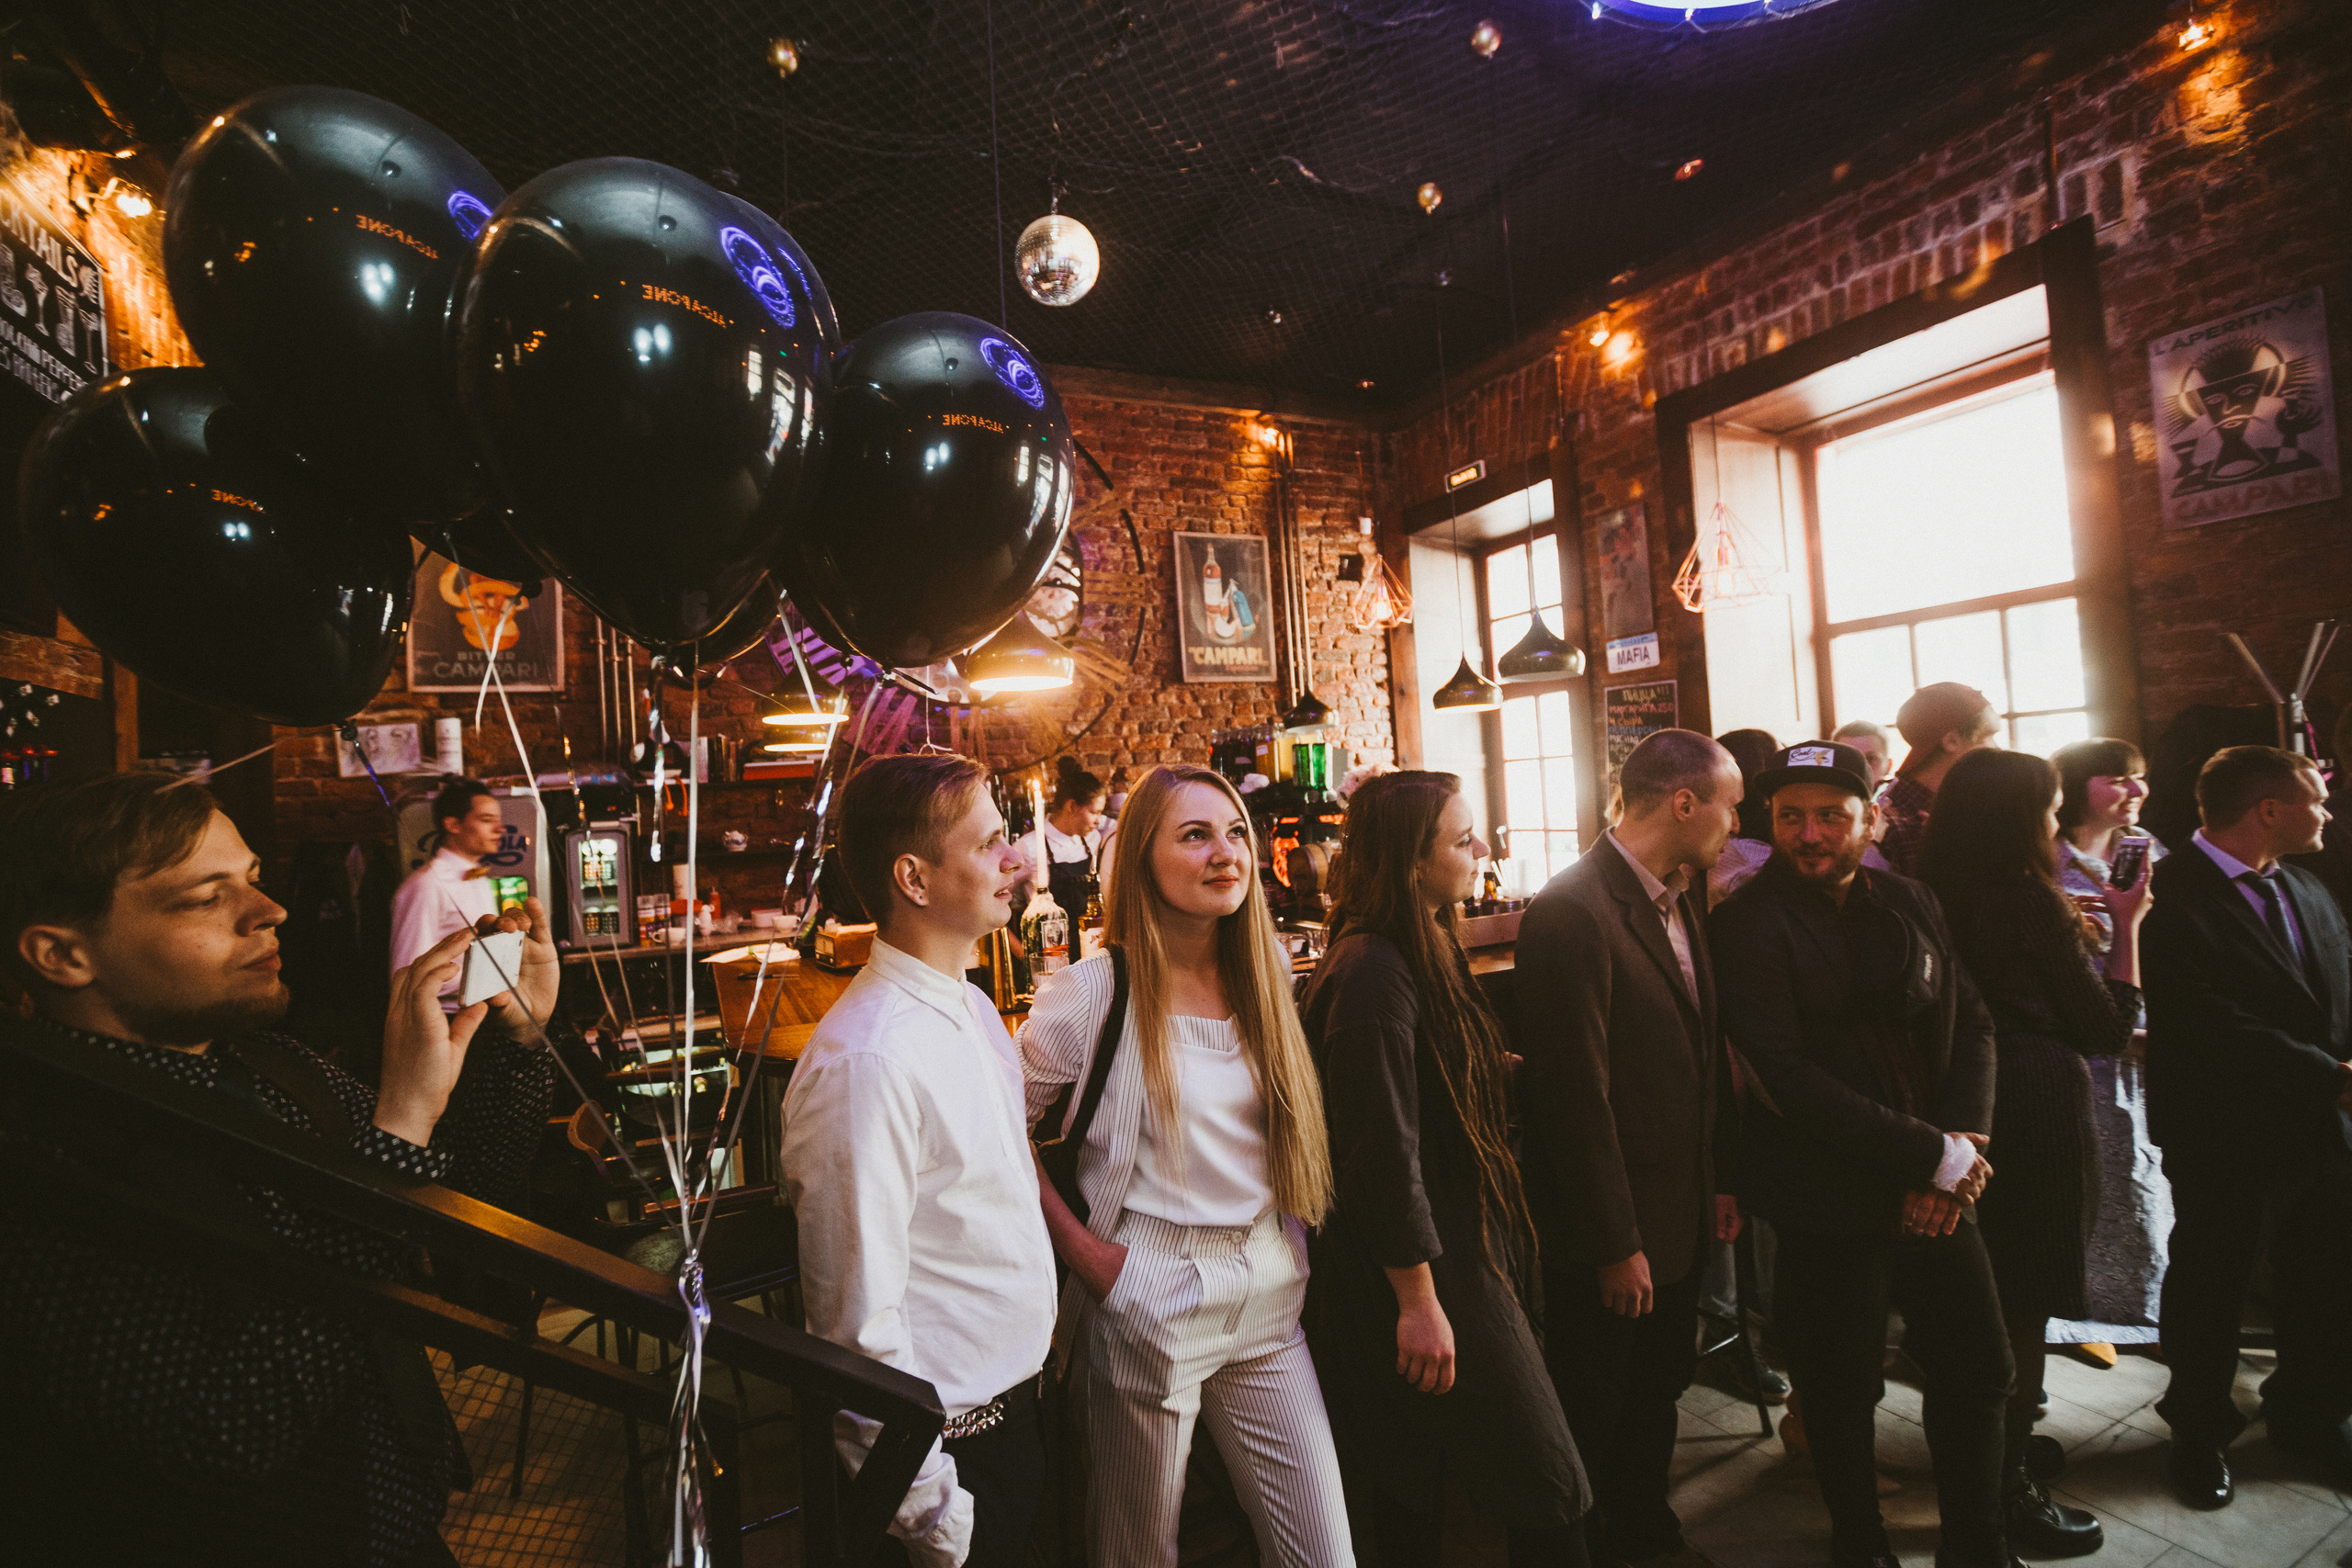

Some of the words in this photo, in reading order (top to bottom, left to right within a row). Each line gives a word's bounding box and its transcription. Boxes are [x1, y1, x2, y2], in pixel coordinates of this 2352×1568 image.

[2172, 471, 2335, 521] CAMPARI
[458, 651, 515, 661] BITER
[1617, 646, 1650, 665] MAFIA
